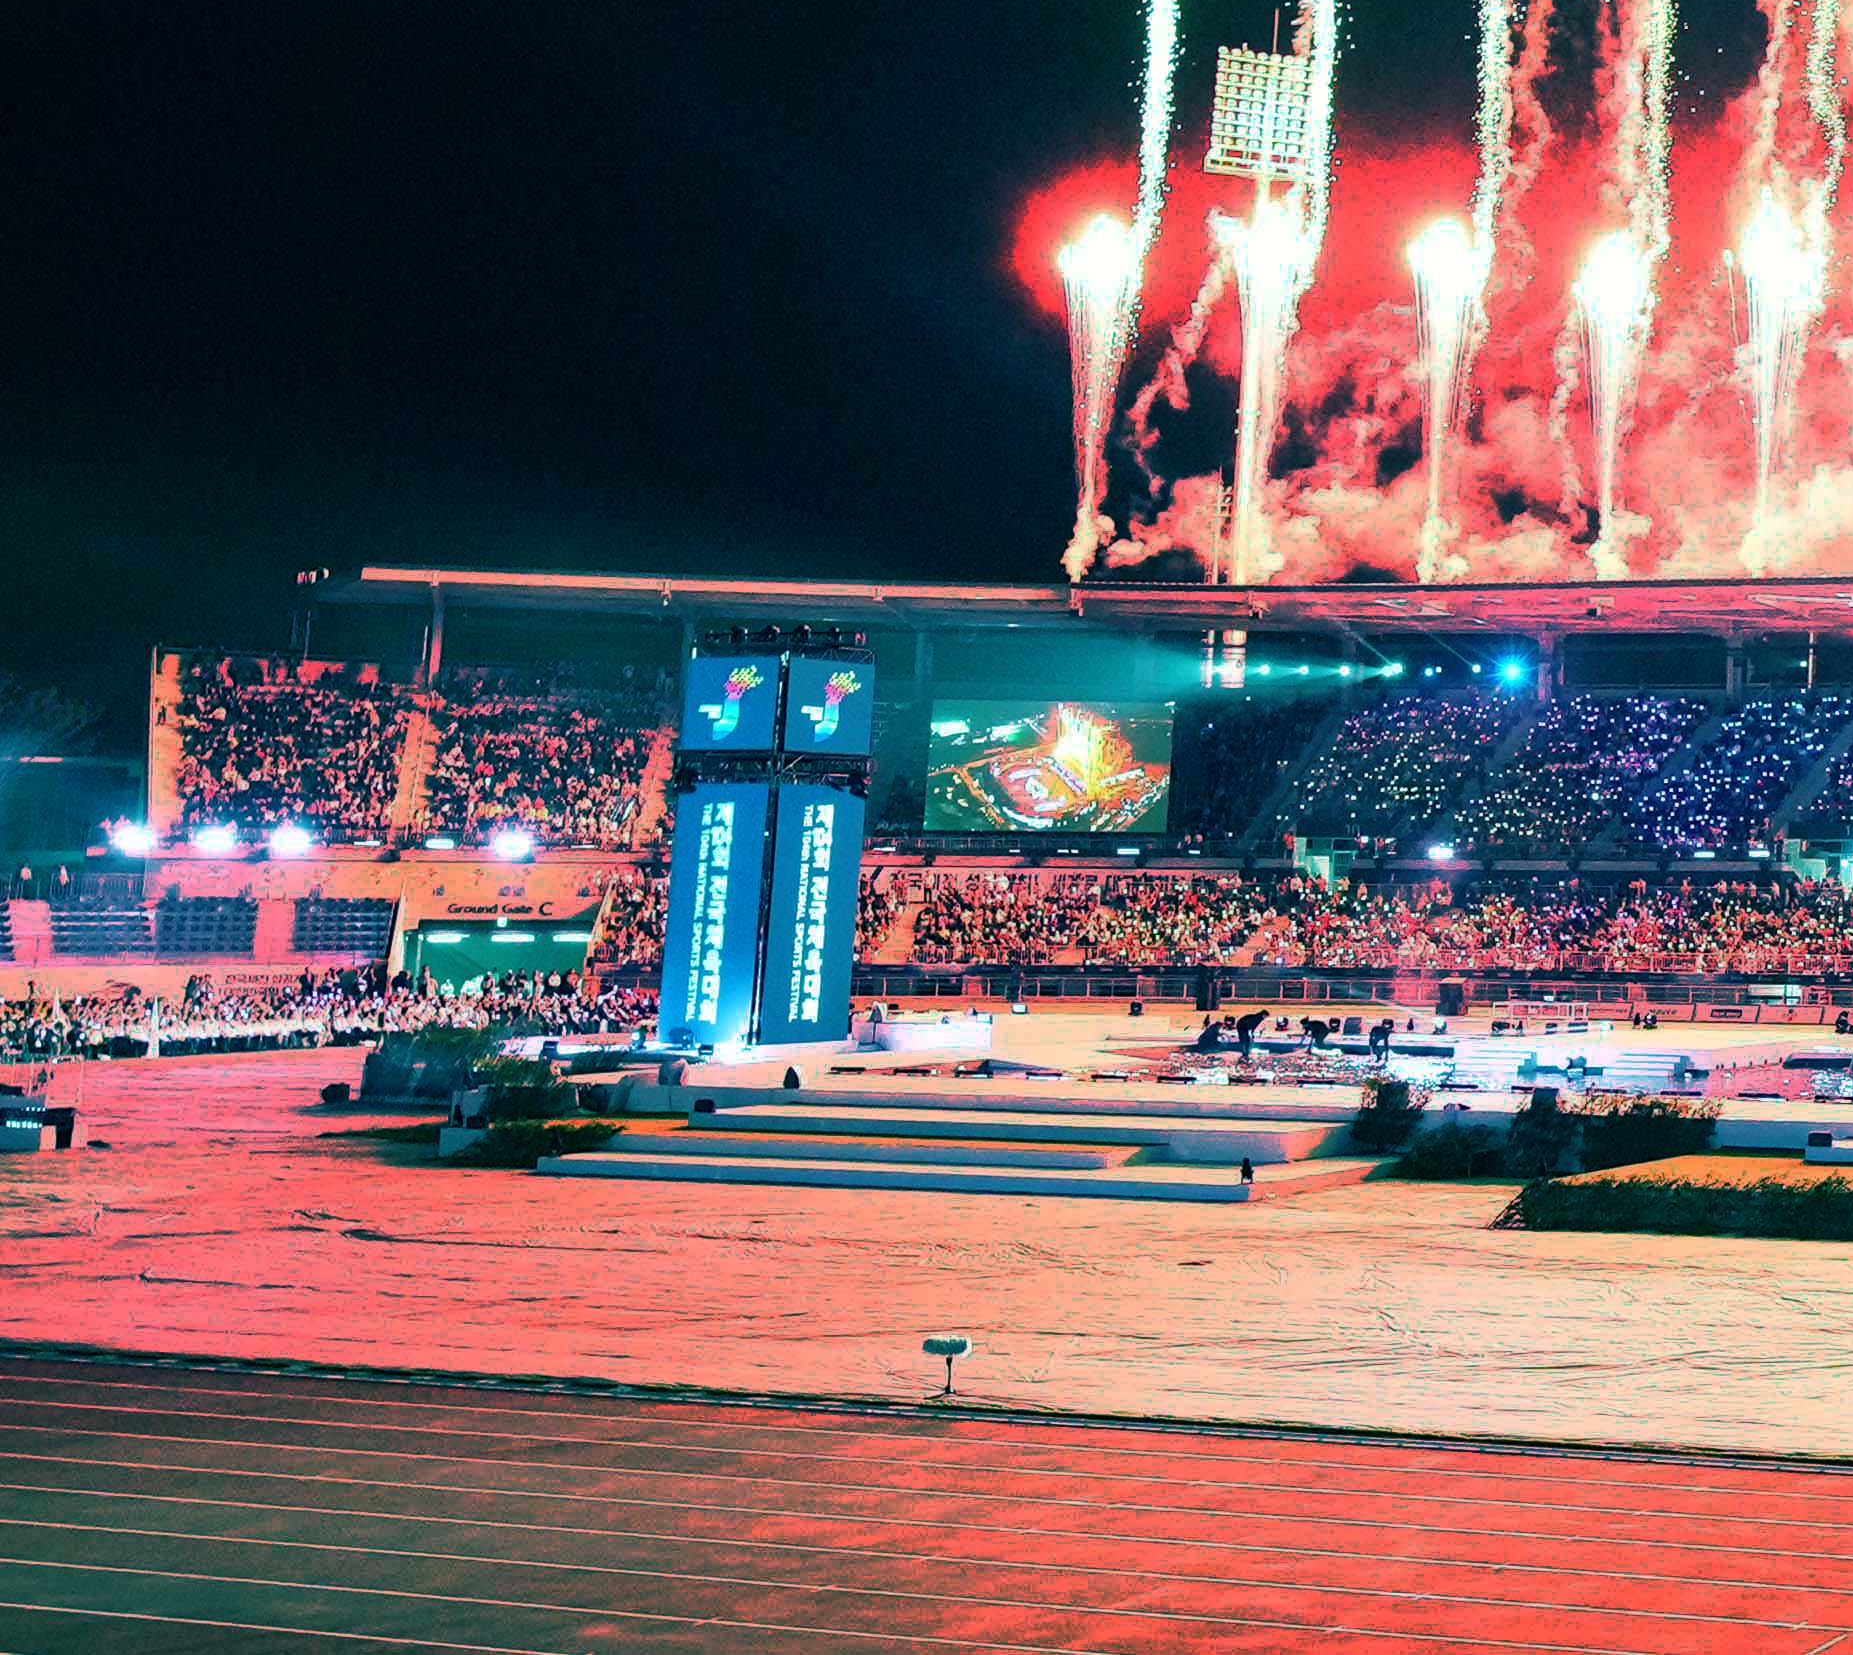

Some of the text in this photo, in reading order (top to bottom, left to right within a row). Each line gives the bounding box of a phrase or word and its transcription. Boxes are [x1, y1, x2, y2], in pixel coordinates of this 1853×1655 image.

[702, 803, 713, 825] THE
[803, 804, 814, 826] THE
[447, 902, 555, 916] Ground Gate C
[694, 862, 708, 920] NATIONAL
[796, 863, 809, 921] NATIONAL
[690, 922, 703, 967] SPORTS
[793, 923, 805, 968] SPORTS
[685, 969, 699, 1023] FESTIVAL
[788, 969, 801, 1023] FESTIVAL
